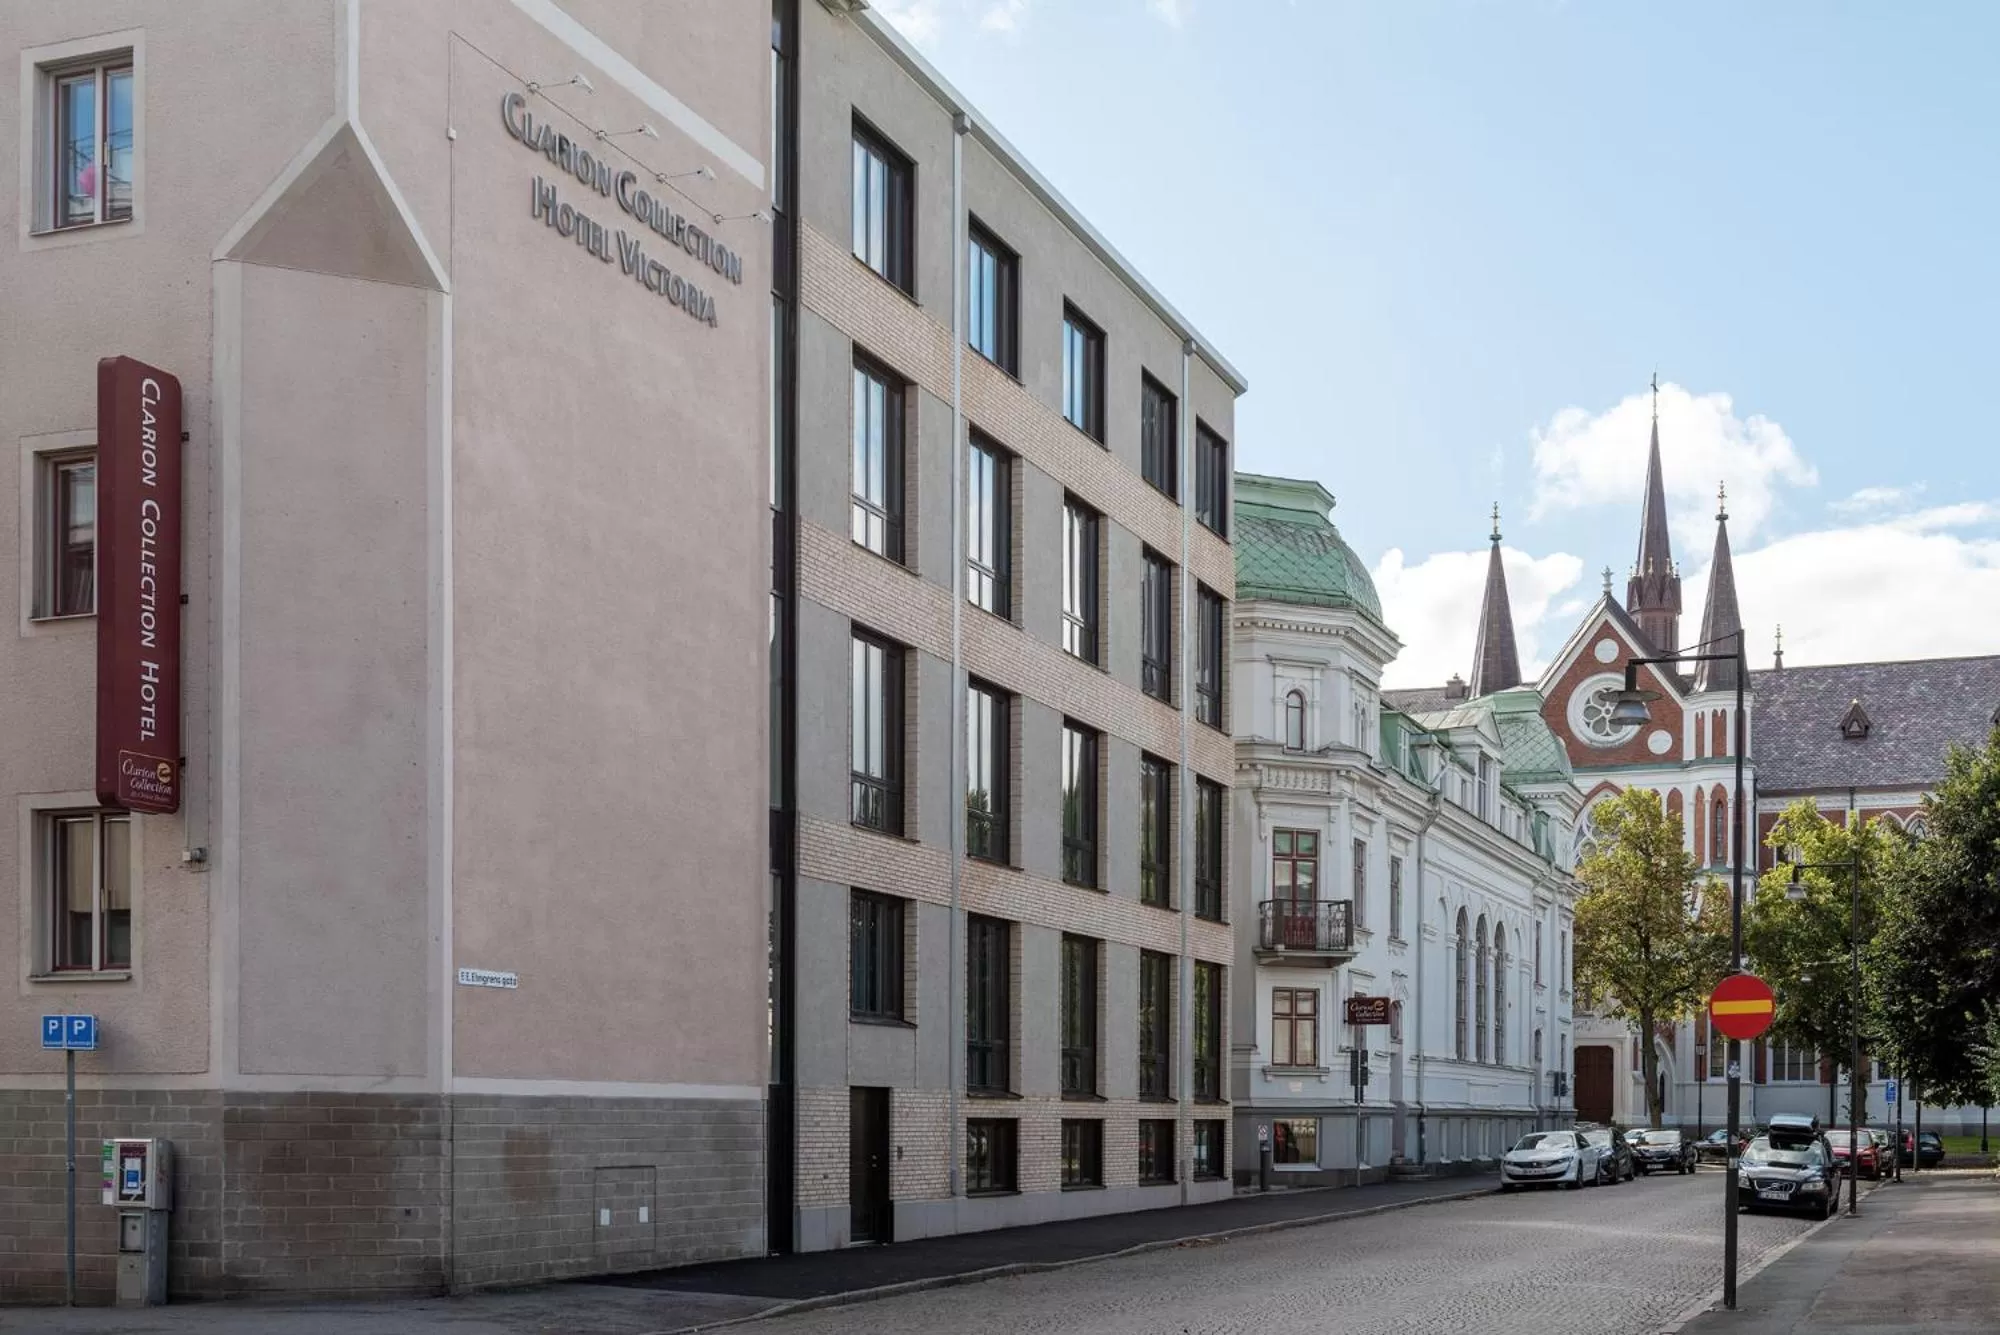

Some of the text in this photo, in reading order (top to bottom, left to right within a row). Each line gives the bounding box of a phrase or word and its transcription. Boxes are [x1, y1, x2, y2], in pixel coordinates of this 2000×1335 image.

[503, 91, 742, 285] CLARION COLLECTION
[532, 175, 718, 329] HOTEL VICTORIA
[141, 378, 161, 742] CLARION COLLECTION HOTEL
[48, 1019, 59, 1036] P
[73, 1019, 87, 1036] P
